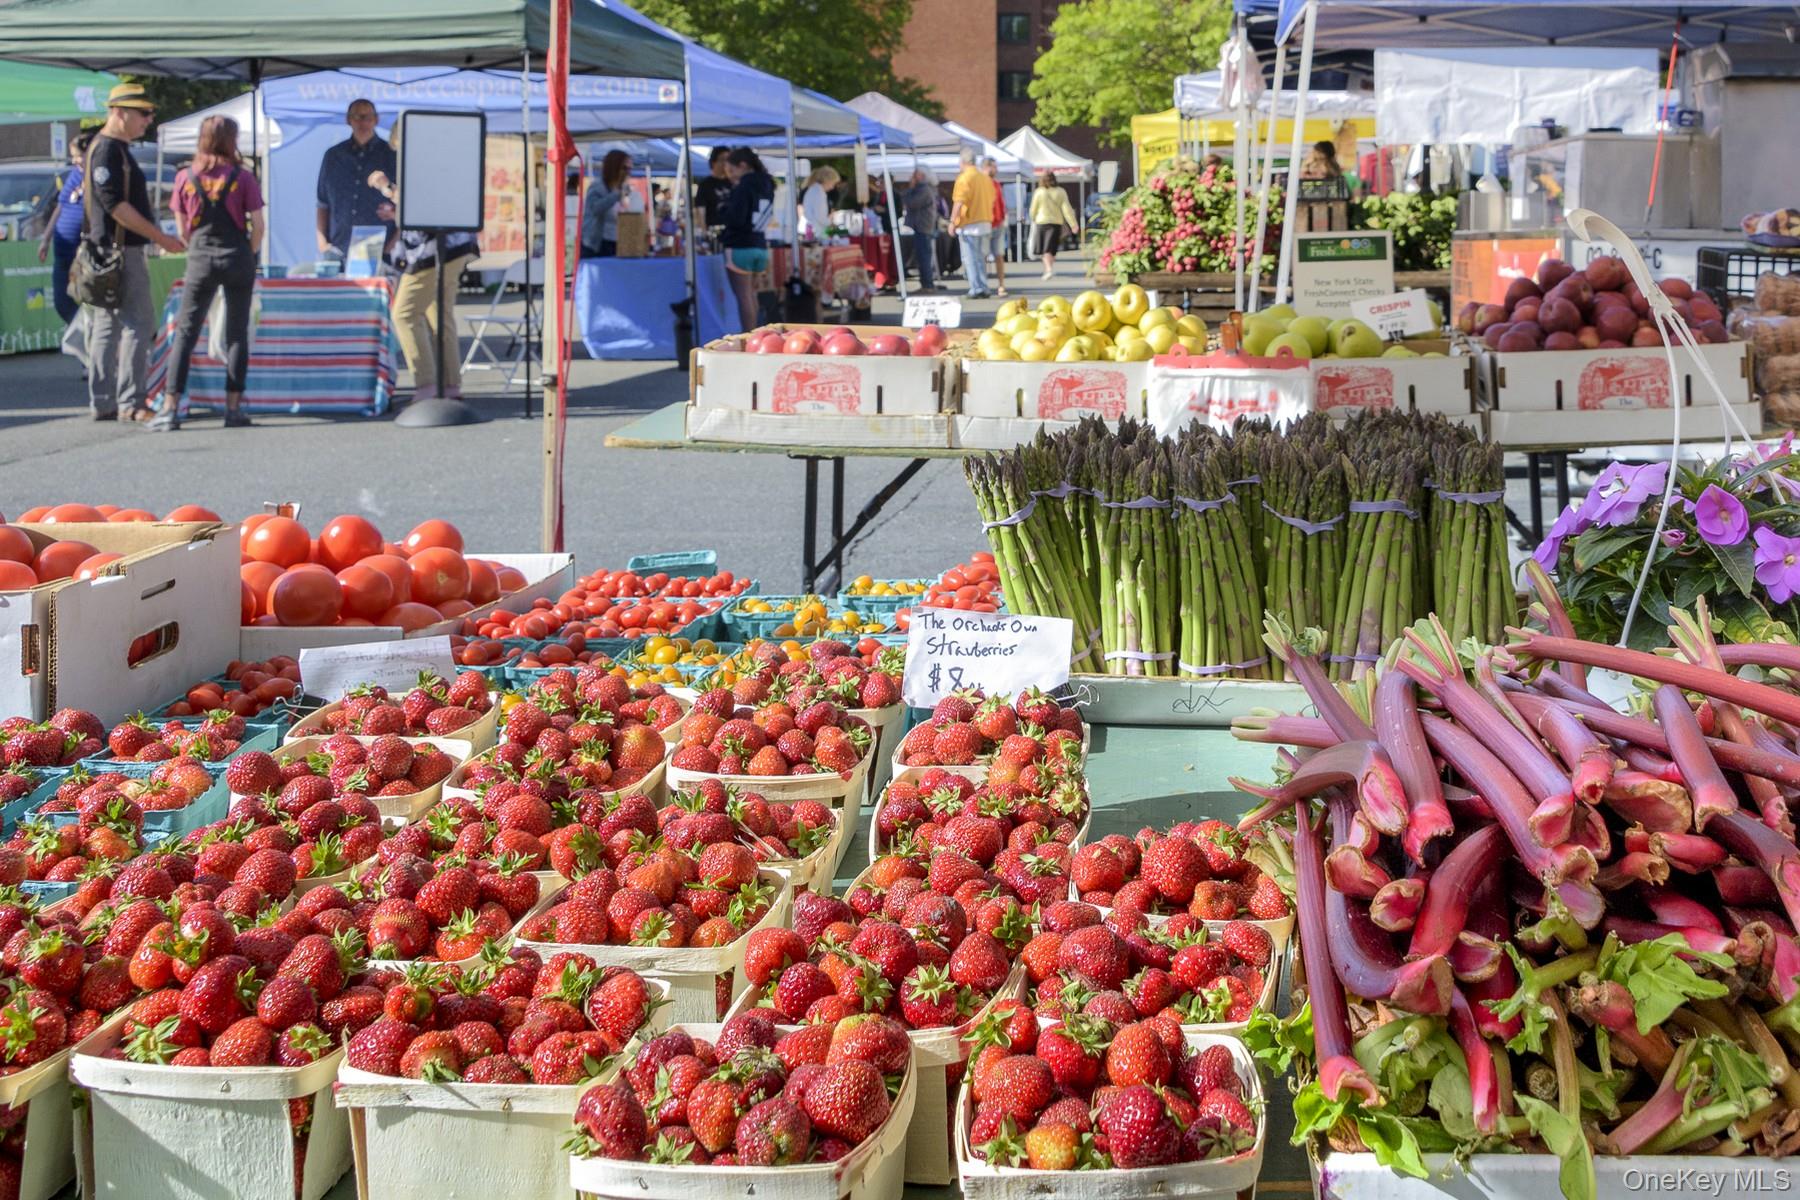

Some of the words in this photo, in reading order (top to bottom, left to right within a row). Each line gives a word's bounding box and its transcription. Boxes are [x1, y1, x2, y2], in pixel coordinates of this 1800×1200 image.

[1354, 278, 1374, 286] State
[1369, 300, 1412, 315] CRISPIN
[918, 612, 946, 630] The
[1010, 620, 1038, 633] Own
[926, 633, 1018, 657] Strawberries
